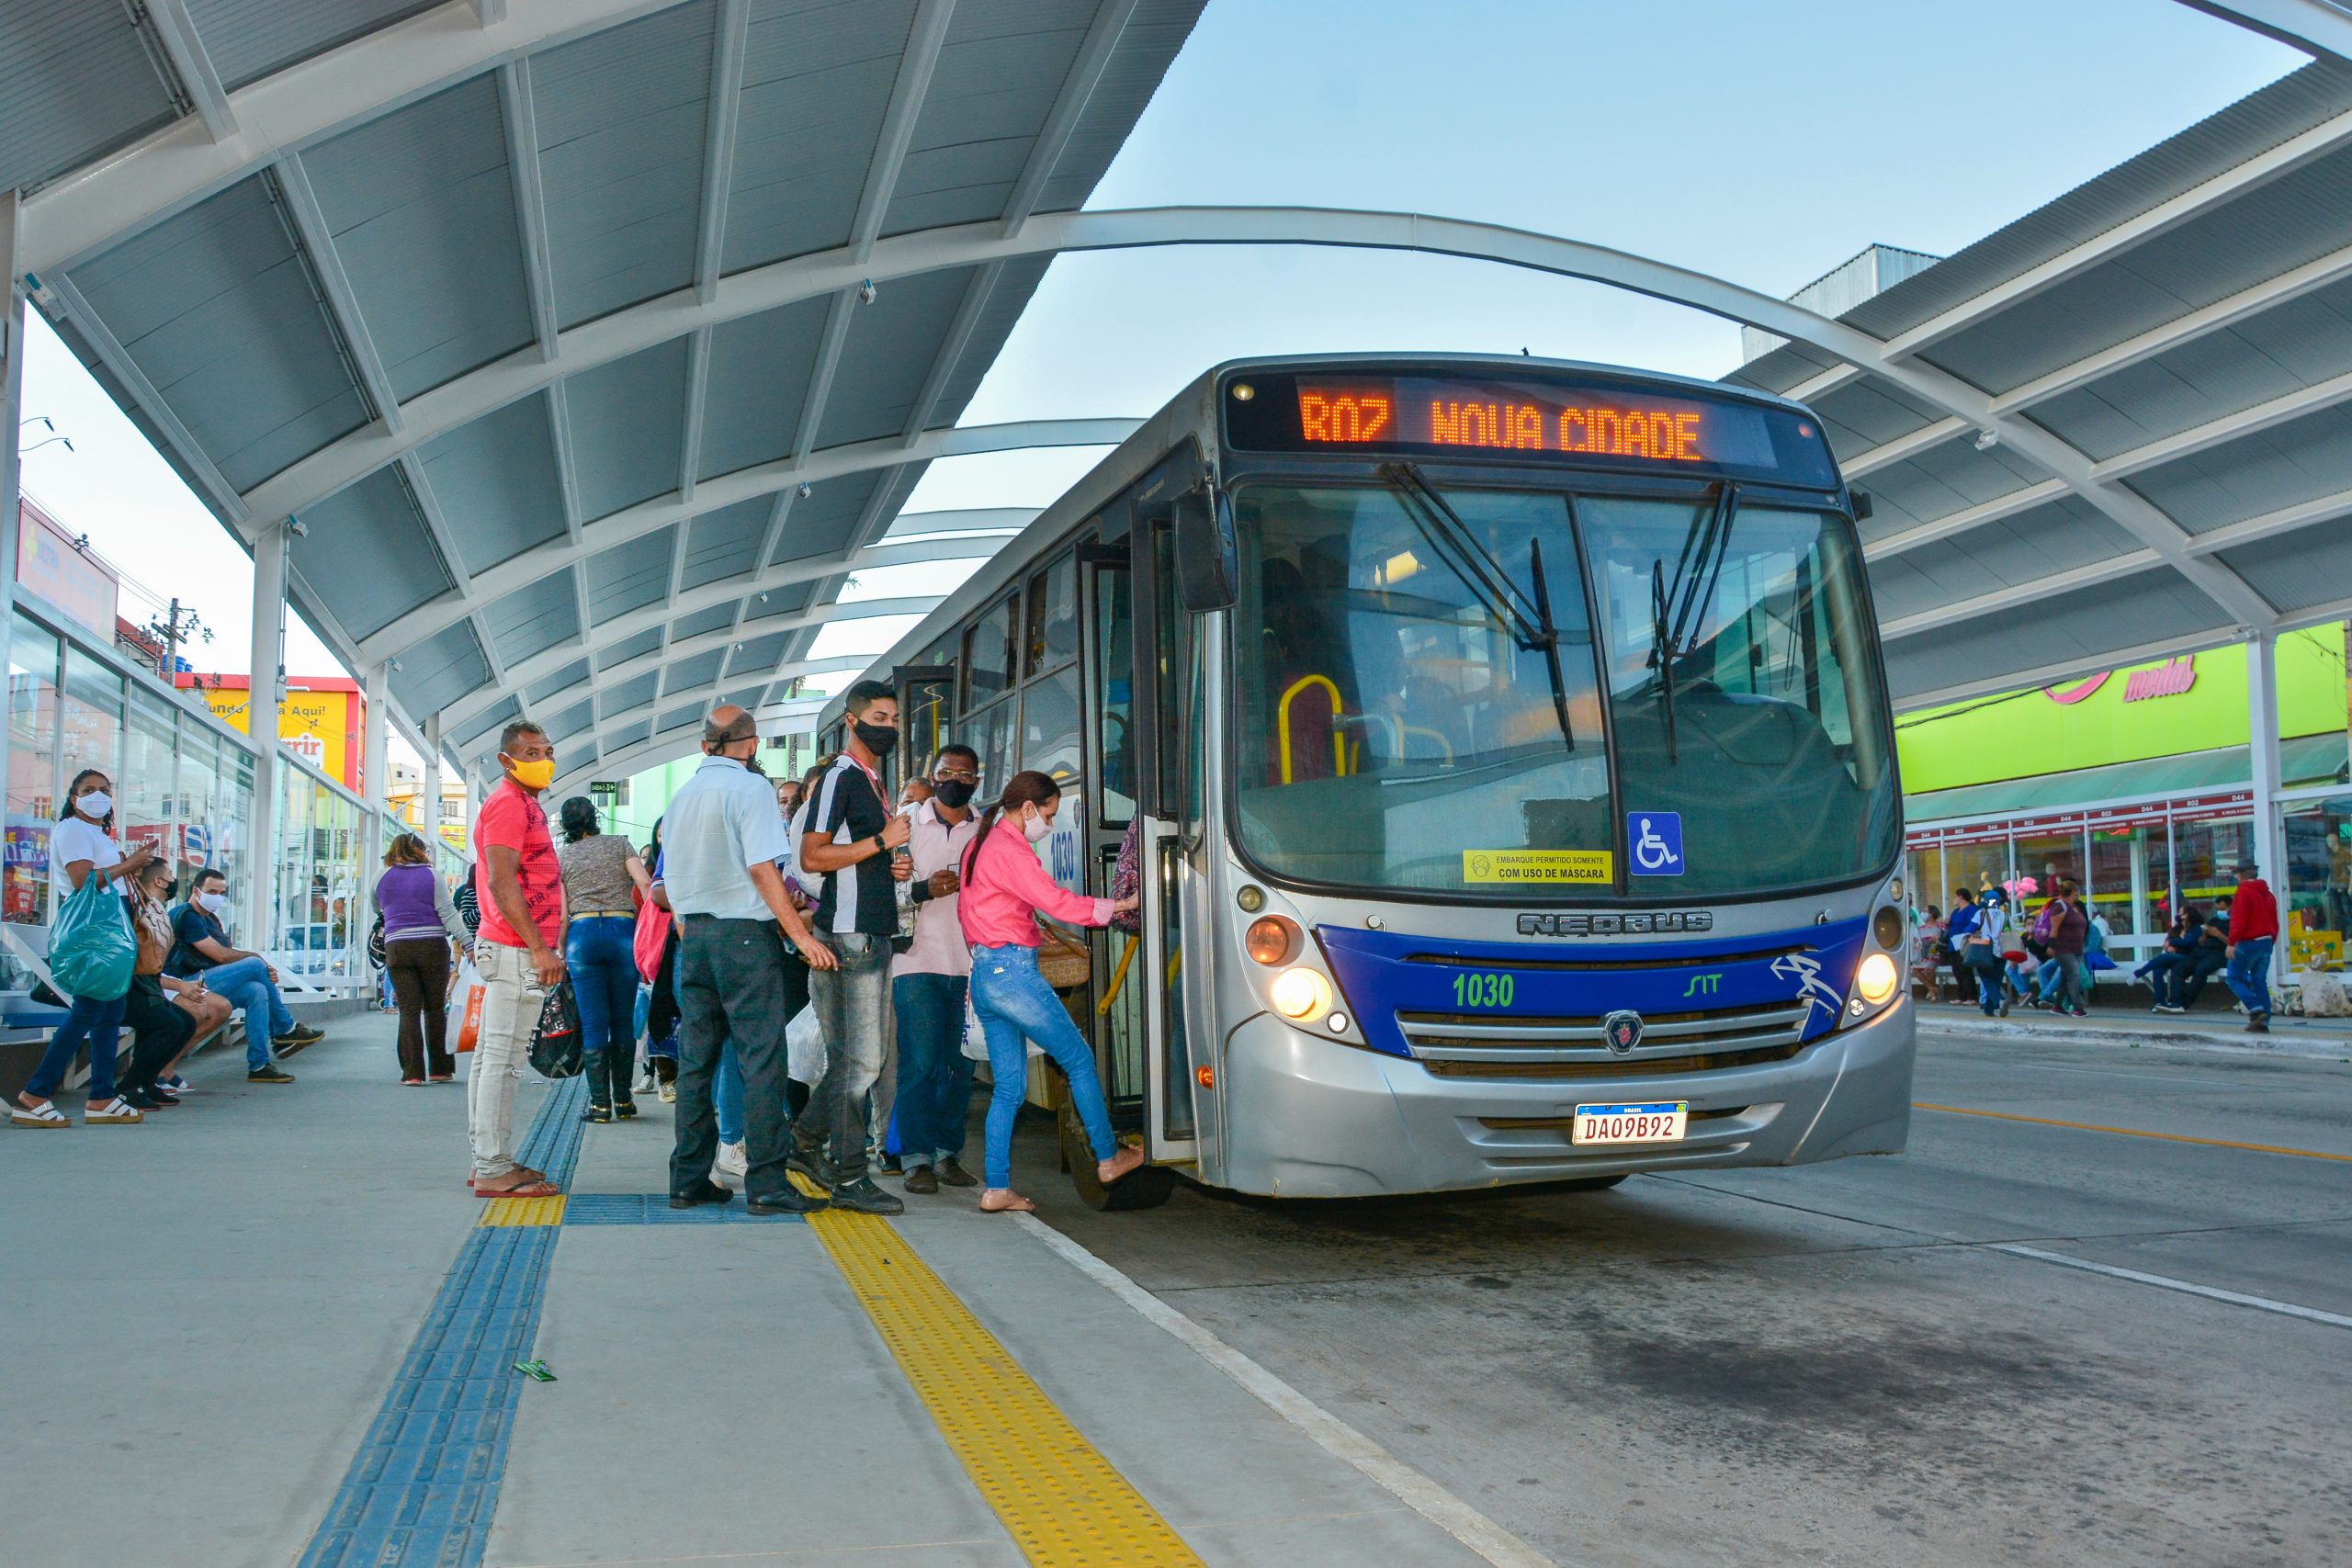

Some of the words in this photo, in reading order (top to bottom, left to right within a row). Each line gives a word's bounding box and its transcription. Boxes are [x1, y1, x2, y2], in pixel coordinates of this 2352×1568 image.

[1302, 396, 1388, 442] R07
[1431, 401, 1543, 450] NOVA
[1559, 408, 1702, 461] CIDADE
[209, 704, 243, 714] undo
[291, 705, 326, 716] Aqui!
[1051, 830, 1074, 881] 1030
[1498, 868, 1520, 878] COM
[1522, 868, 1542, 878] USO
[1545, 868, 1557, 878] DE
[1560, 866, 1604, 879] MÁSCARA
[1517, 911, 1713, 935] NEOBUS
[1453, 973, 1514, 1008] 1030
[1683, 974, 1723, 997] SIT
